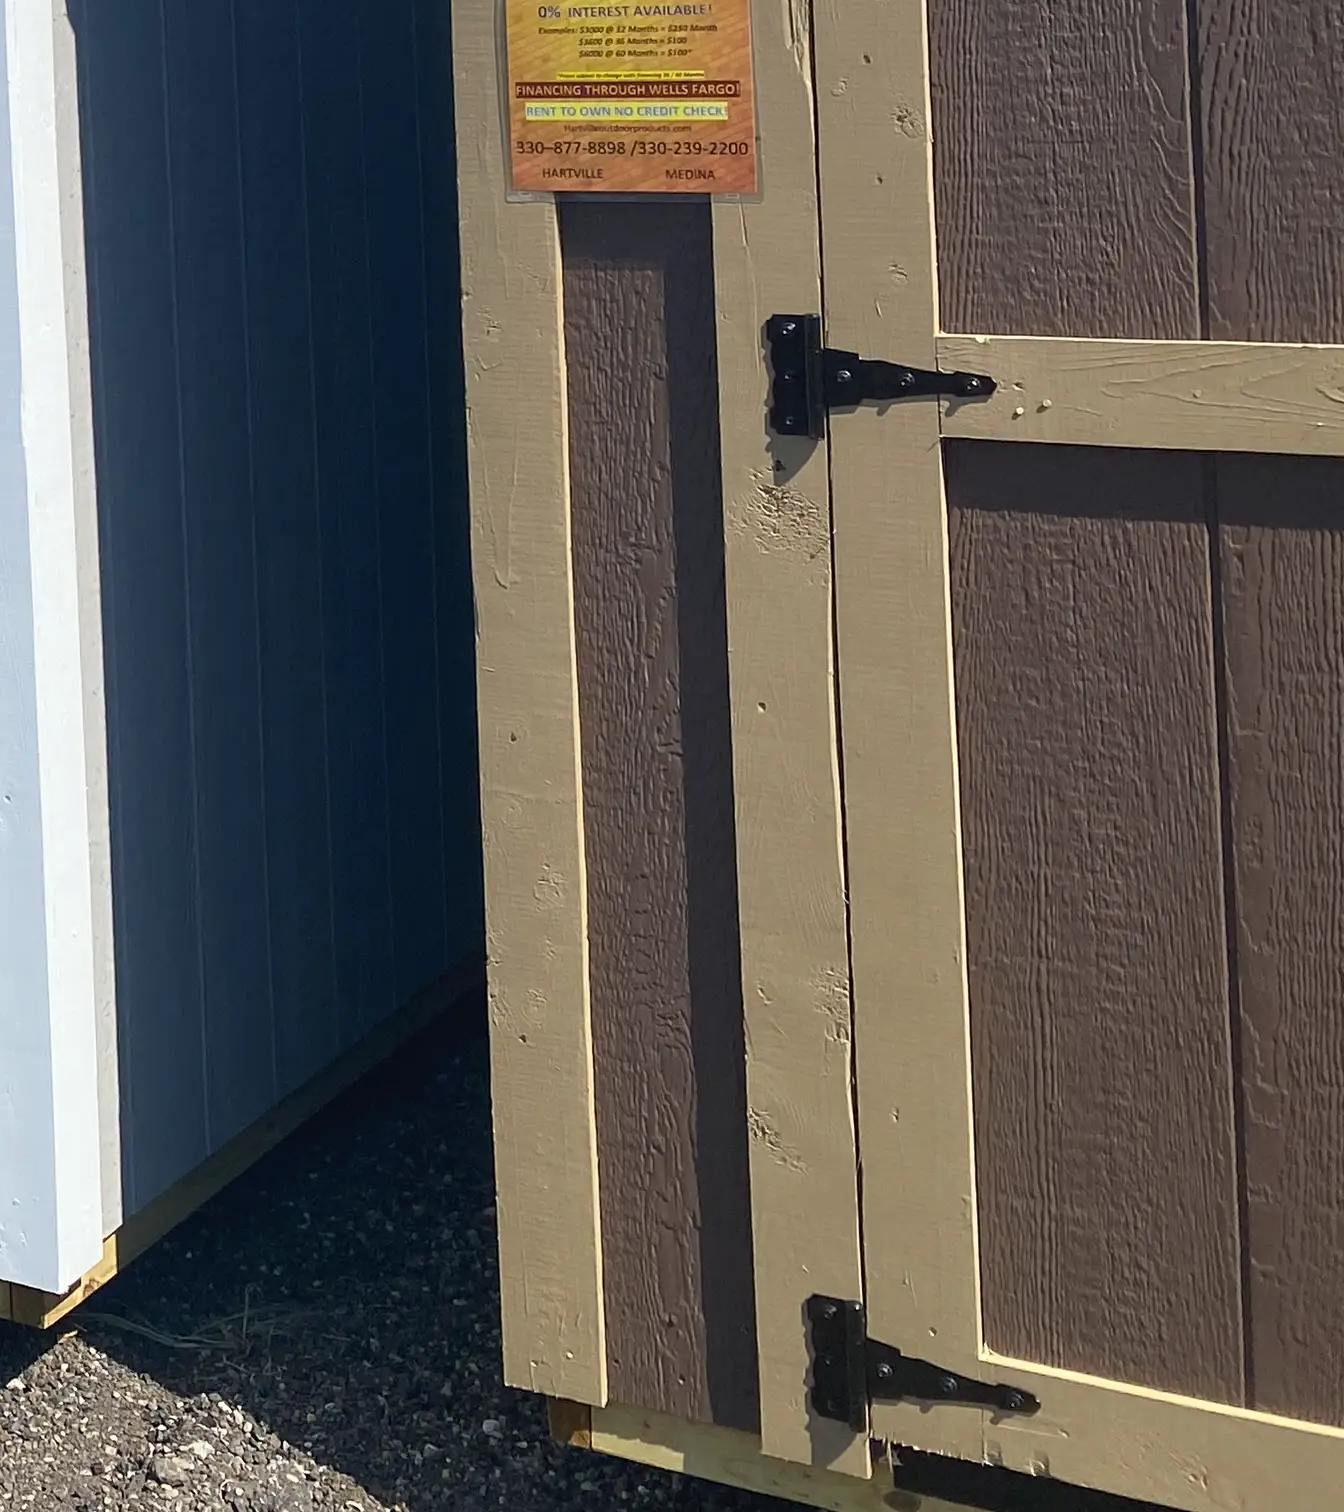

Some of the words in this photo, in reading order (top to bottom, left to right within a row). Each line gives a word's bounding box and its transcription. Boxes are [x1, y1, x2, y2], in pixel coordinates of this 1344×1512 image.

[538, 5, 561, 18] 0%
[568, 5, 630, 18] INTEREST
[634, 3, 712, 16] AVAILABLE!
[627, 25, 659, 33] Months
[627, 37, 658, 45] Months
[627, 49, 658, 57] Months
[516, 85, 581, 96] FINANCING
[585, 84, 646, 96] THROUGH
[648, 84, 688, 95] WELLS
[692, 83, 740, 95] FARGO!
[526, 107, 556, 117] RENT
[560, 107, 576, 117] TO
[580, 106, 611, 117] OWN
[614, 106, 633, 117] NO
[637, 106, 679, 116] CREDIT
[542, 168, 604, 179] HARTVILLE
[665, 169, 716, 181] MEDINA
